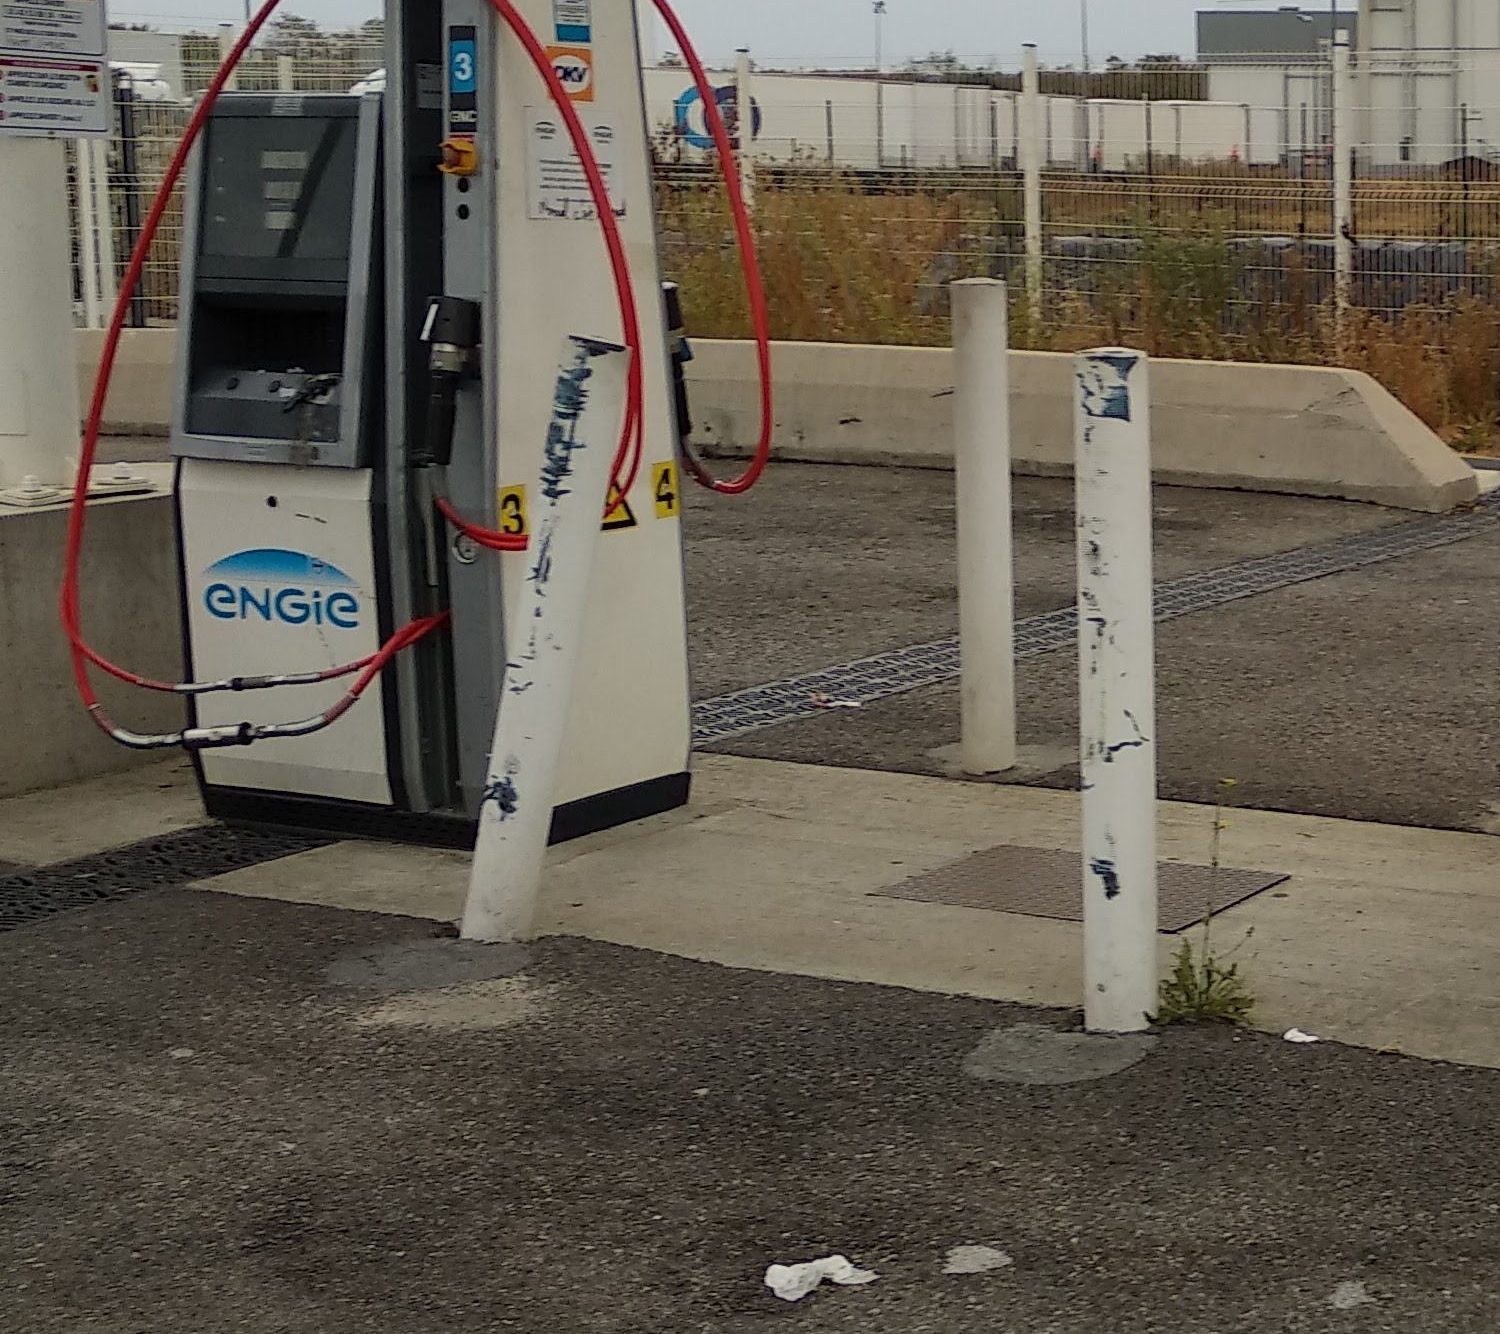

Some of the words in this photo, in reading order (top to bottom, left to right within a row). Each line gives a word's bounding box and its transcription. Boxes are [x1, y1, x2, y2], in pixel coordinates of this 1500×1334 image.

[454, 52, 473, 81] 3
[655, 468, 675, 510] 4
[501, 493, 524, 535] 3
